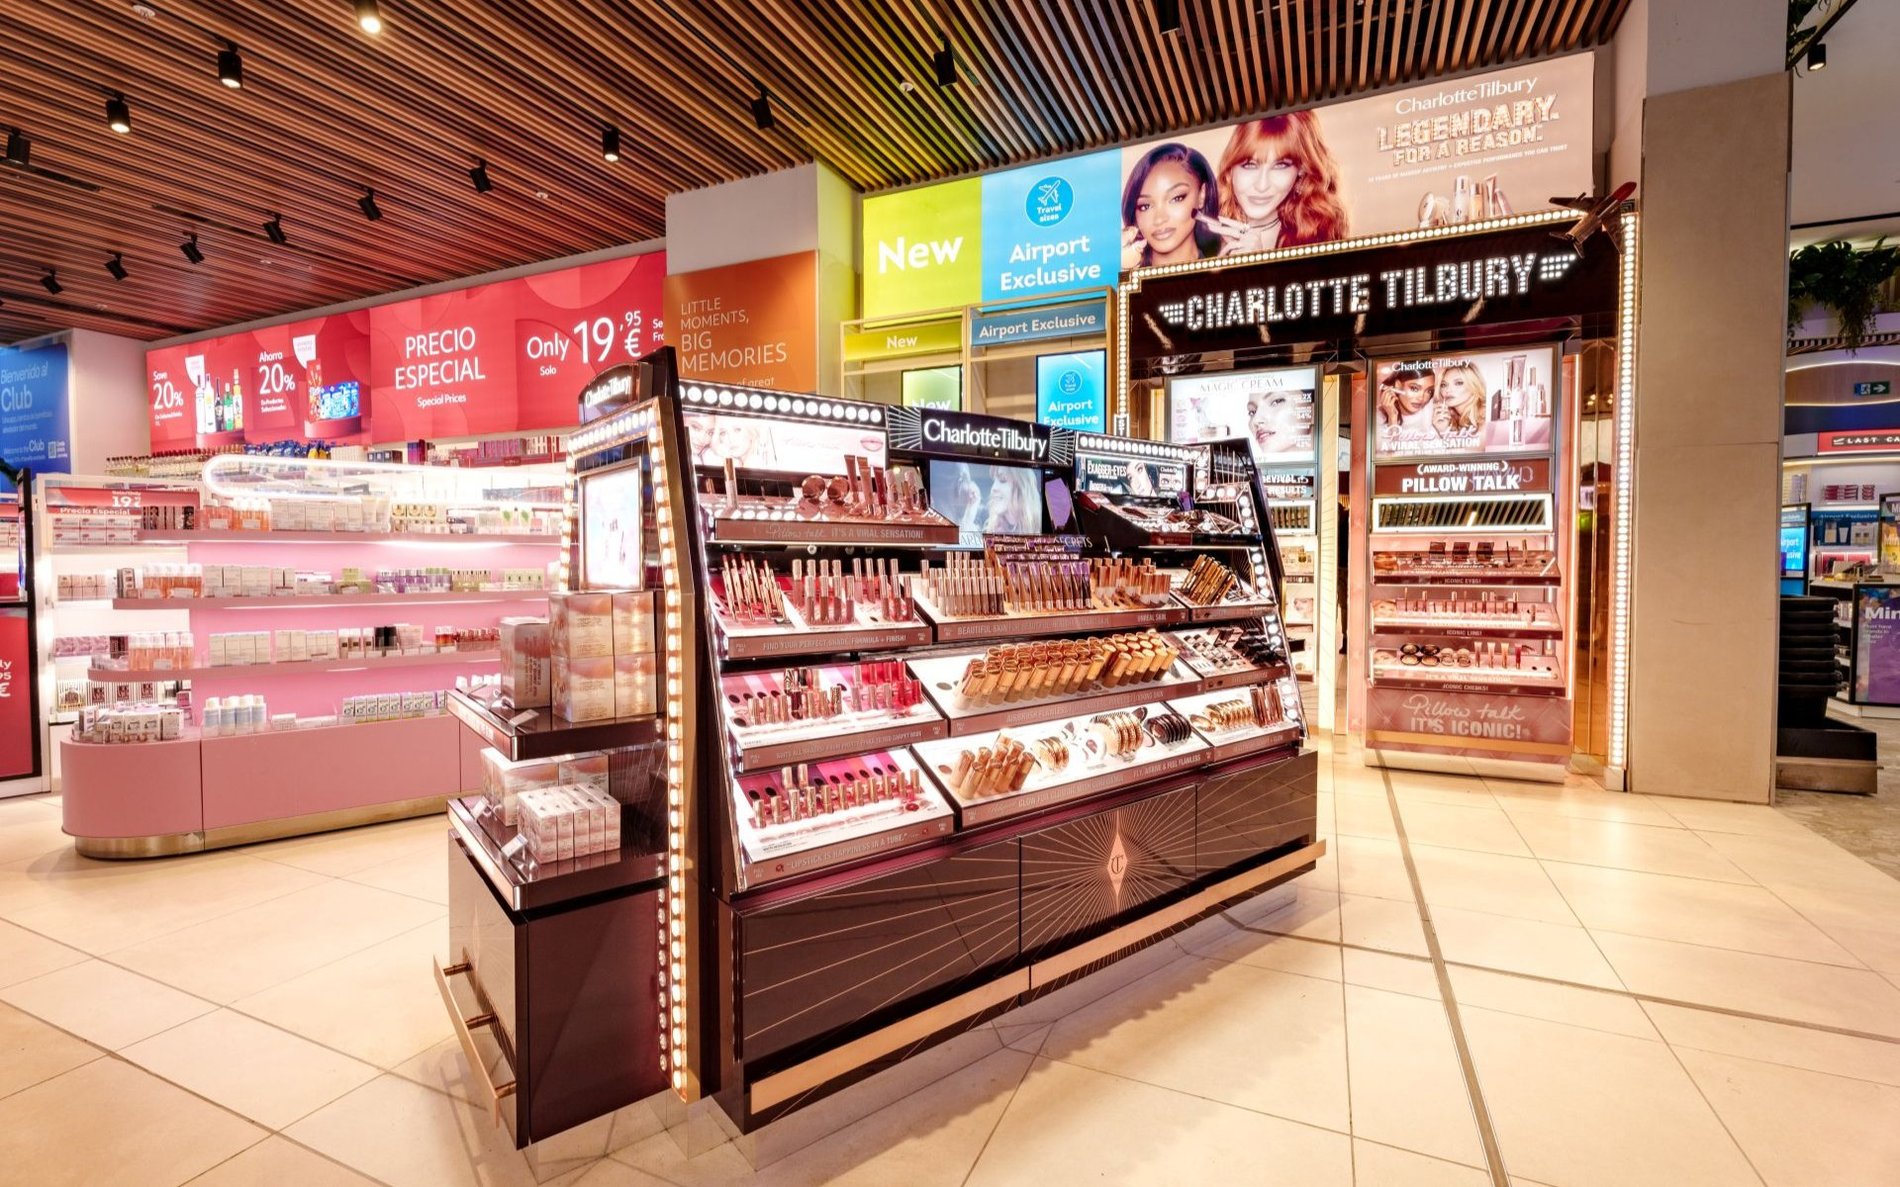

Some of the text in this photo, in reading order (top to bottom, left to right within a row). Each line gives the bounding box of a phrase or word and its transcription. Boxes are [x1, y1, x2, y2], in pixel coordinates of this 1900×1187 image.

[1377, 93, 1560, 152] LEGENDARY.
[1392, 145, 1431, 166] FOR
[1436, 142, 1450, 158] A
[1036, 203, 1062, 215] Travel
[1039, 213, 1060, 223] sizes
[878, 236, 963, 275] New
[1009, 235, 1091, 264] Airport
[1000, 264, 1102, 292] Exclusive
[1186, 252, 1537, 331] CHARLOTTE TILBURY
[680, 297, 721, 316] LITTLE
[680, 309, 750, 330] MOMENTS,
[979, 313, 1096, 340] Airport Exclusive
[405, 326, 476, 359] PRECIO
[527, 333, 570, 361] Only
[681, 331, 712, 353] BIG
[887, 335, 918, 349] New
[259, 351, 283, 362] Ahorra
[681, 342, 788, 374] MEMORIES
[259, 362, 296, 395] 20%
[395, 357, 486, 390] ESPECIAL
[540, 365, 557, 376] Solo
[1, 384, 32, 412] Club
[153, 381, 184, 410] 20%
[417, 393, 467, 408] Special Prices
[1048, 398, 1093, 414] Airport
[1043, 413, 1099, 428] Exclusive
[29, 440, 45, 452] Club
[1423, 462, 1500, 474] AWARD-WINNING
[1402, 474, 1521, 493] PILLOW TALK
[60, 507, 130, 516] Precio Especial
[857, 529, 877, 538] VIRAL
[880, 530, 924, 539] SENSATION!
[1402, 693, 1527, 721] Pillow talk
[1410, 717, 1521, 739] IT'S ICONIC!
